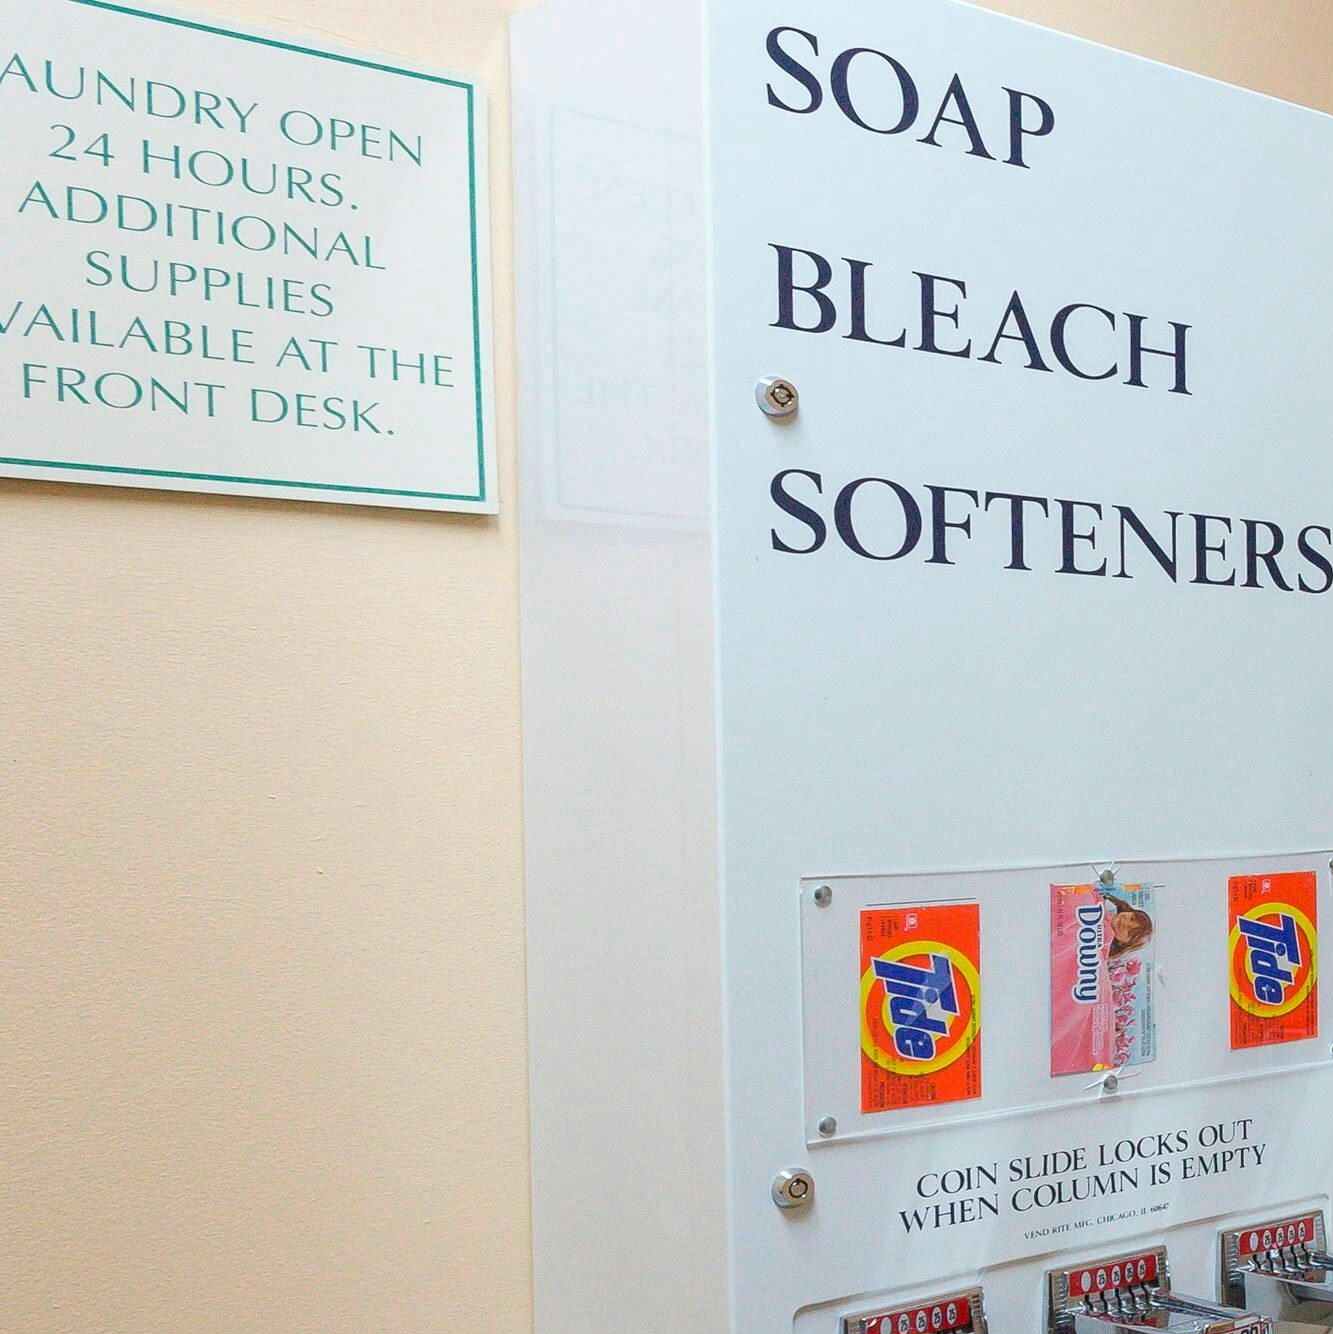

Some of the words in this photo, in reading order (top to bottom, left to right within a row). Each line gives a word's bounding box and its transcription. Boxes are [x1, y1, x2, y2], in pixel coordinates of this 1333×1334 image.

[279, 110, 423, 167] OPEN
[765, 26, 1056, 169] SOAP
[48, 124, 115, 167] 24
[142, 139, 359, 210] HOURS.
[17, 180, 387, 271] ADDITIONAL
[85, 250, 334, 317] SUPPLIES
[767, 243, 1193, 396] BLEACH
[22, 363, 226, 418] FRONT
[250, 388, 395, 436] DESK.
[275, 337, 338, 375] AT
[357, 345, 456, 388] THE
[1073, 904, 1102, 1001] Downy
[1236, 912, 1302, 1006] Tide
[870, 953, 960, 1061] Tide
[899, 1193, 1000, 1234] WHEN
[1011, 1167, 1140, 1212] COLUMN
[1150, 1161, 1171, 1186] IS
[1181, 1143, 1267, 1180] EMPTY
[916, 1162, 998, 1198] COIN
[1008, 1147, 1088, 1181] SLIDE
[1098, 1129, 1189, 1167] LOCKS
[1197, 1118, 1254, 1147] OUT
[1024, 1228, 1050, 1240] VEND
[1052, 1224, 1071, 1234] RITE
[900, 1319, 908, 1332] 25
[917, 1315, 926, 1328] 25
